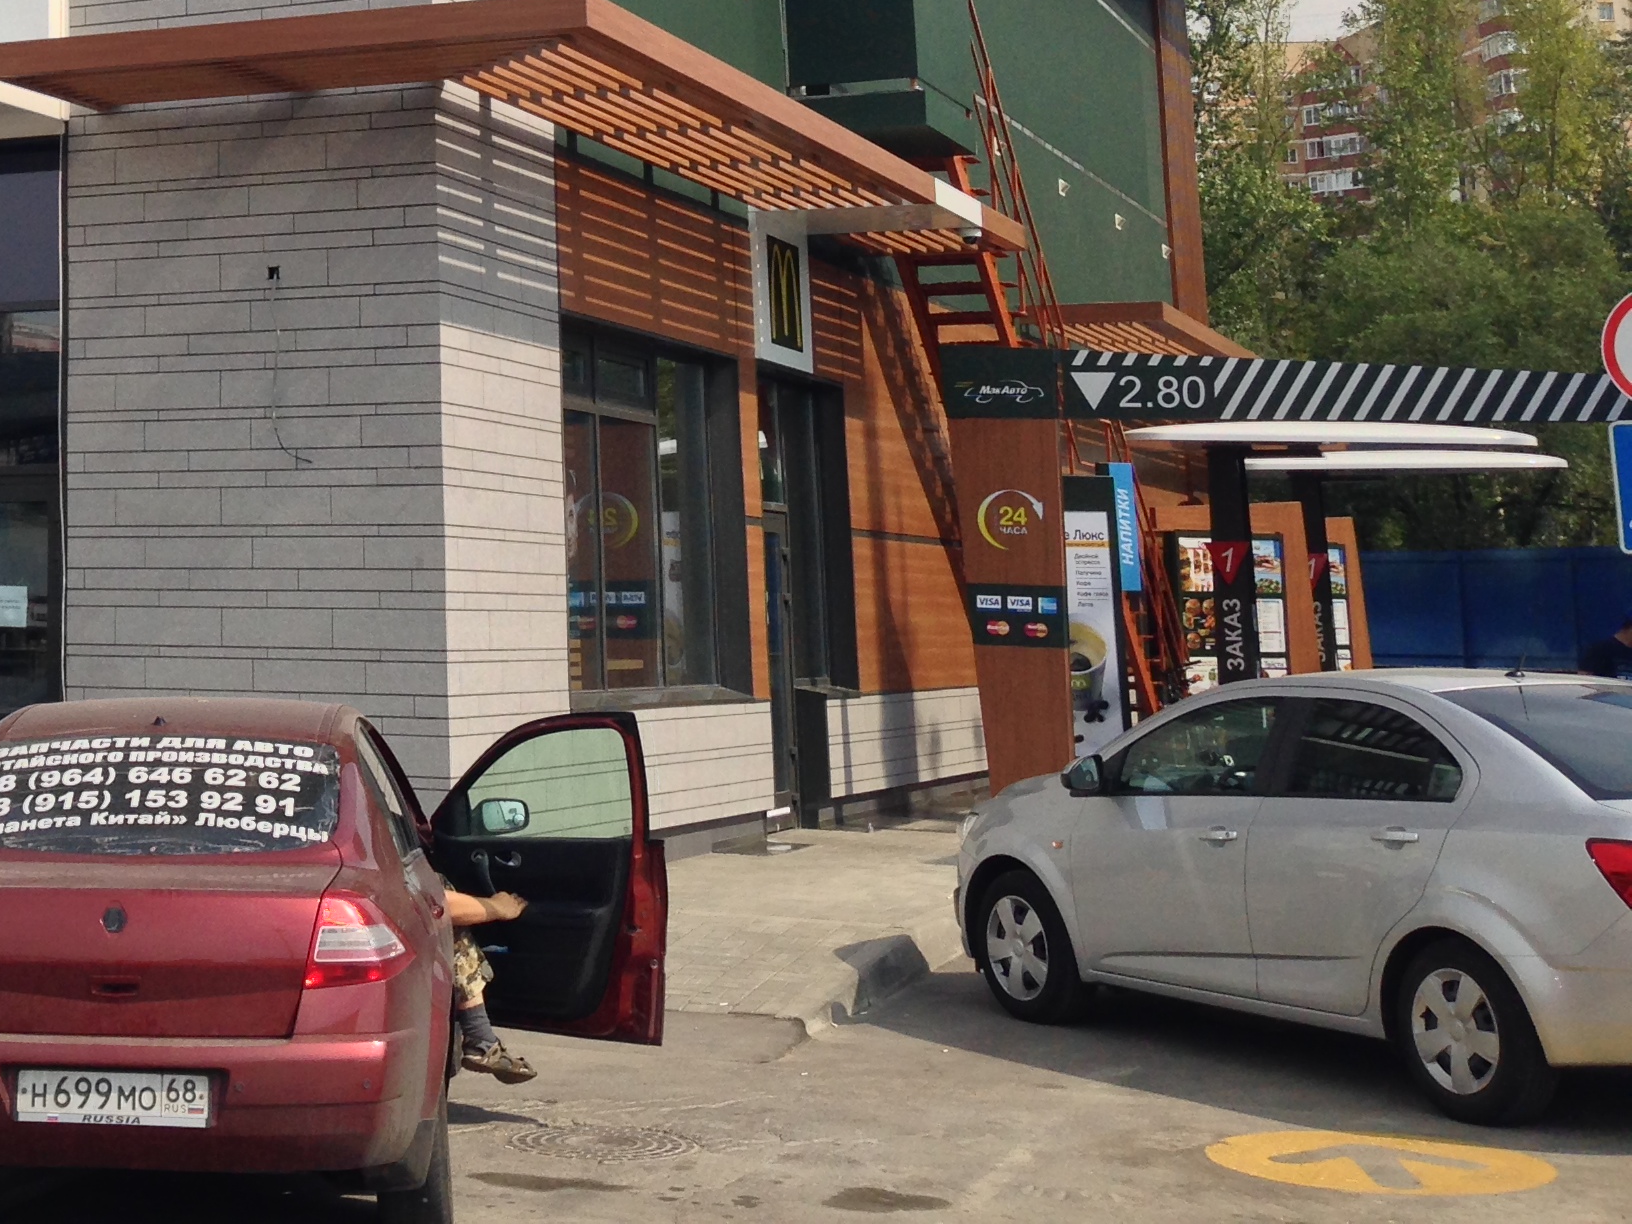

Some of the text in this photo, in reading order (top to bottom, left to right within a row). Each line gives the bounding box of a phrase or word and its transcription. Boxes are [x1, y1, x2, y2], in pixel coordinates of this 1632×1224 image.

[1119, 375, 1206, 409] 2.80
[999, 505, 1028, 526] 24
[1117, 487, 1135, 566] НАПИТКИ
[999, 526, 1028, 535] ЧАСА
[1073, 529, 1105, 541] Люкс
[1221, 547, 1234, 573] 1
[979, 597, 1000, 606] VISA
[1010, 598, 1031, 607] VISA
[1222, 598, 1245, 672] ЗАКАЗ
[156, 736, 228, 751] ДЛЯ
[232, 739, 315, 758] АВТО
[128, 750, 330, 775] ПРОИЗВОДСТВА
[27, 766, 117, 792] (964)
[127, 766, 193, 785] 646
[204, 767, 247, 787] 62
[258, 770, 302, 792] 62
[21, 790, 112, 816] (915)
[124, 789, 189, 809] 153
[200, 791, 243, 812] 92
[255, 794, 295, 818] 91
[89, 810, 188, 827] Китай»
[194, 812, 329, 843] Люберцы
[166, 1078, 197, 1104] 68
[81, 1114, 141, 1125] RUSSIA
[164, 1104, 186, 1114] RUS
